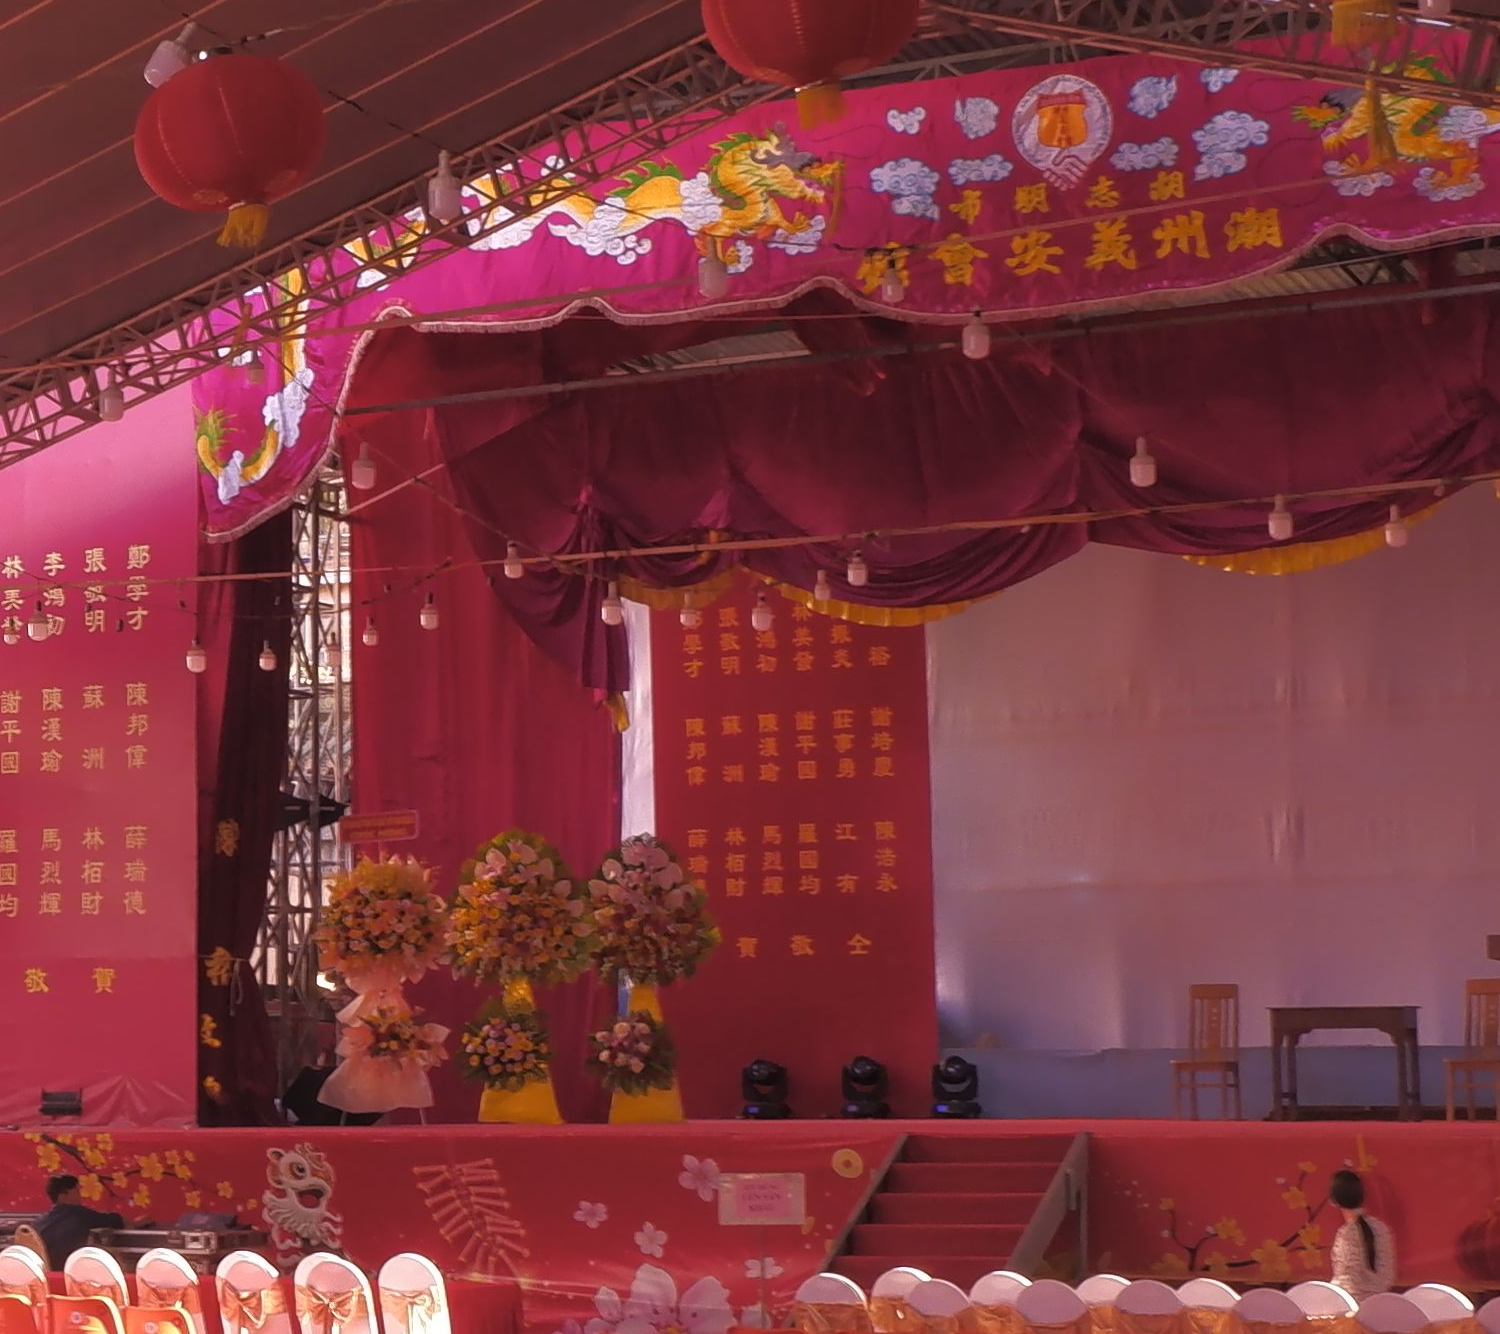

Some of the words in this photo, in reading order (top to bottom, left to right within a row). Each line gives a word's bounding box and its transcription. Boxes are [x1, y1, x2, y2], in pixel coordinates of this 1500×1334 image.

[0, 690, 23, 775] 謝平國
[40, 687, 64, 773] 陳漢瑜
[125, 682, 149, 769] 陳邦偉
[39, 828, 62, 917] 馬烈輝
